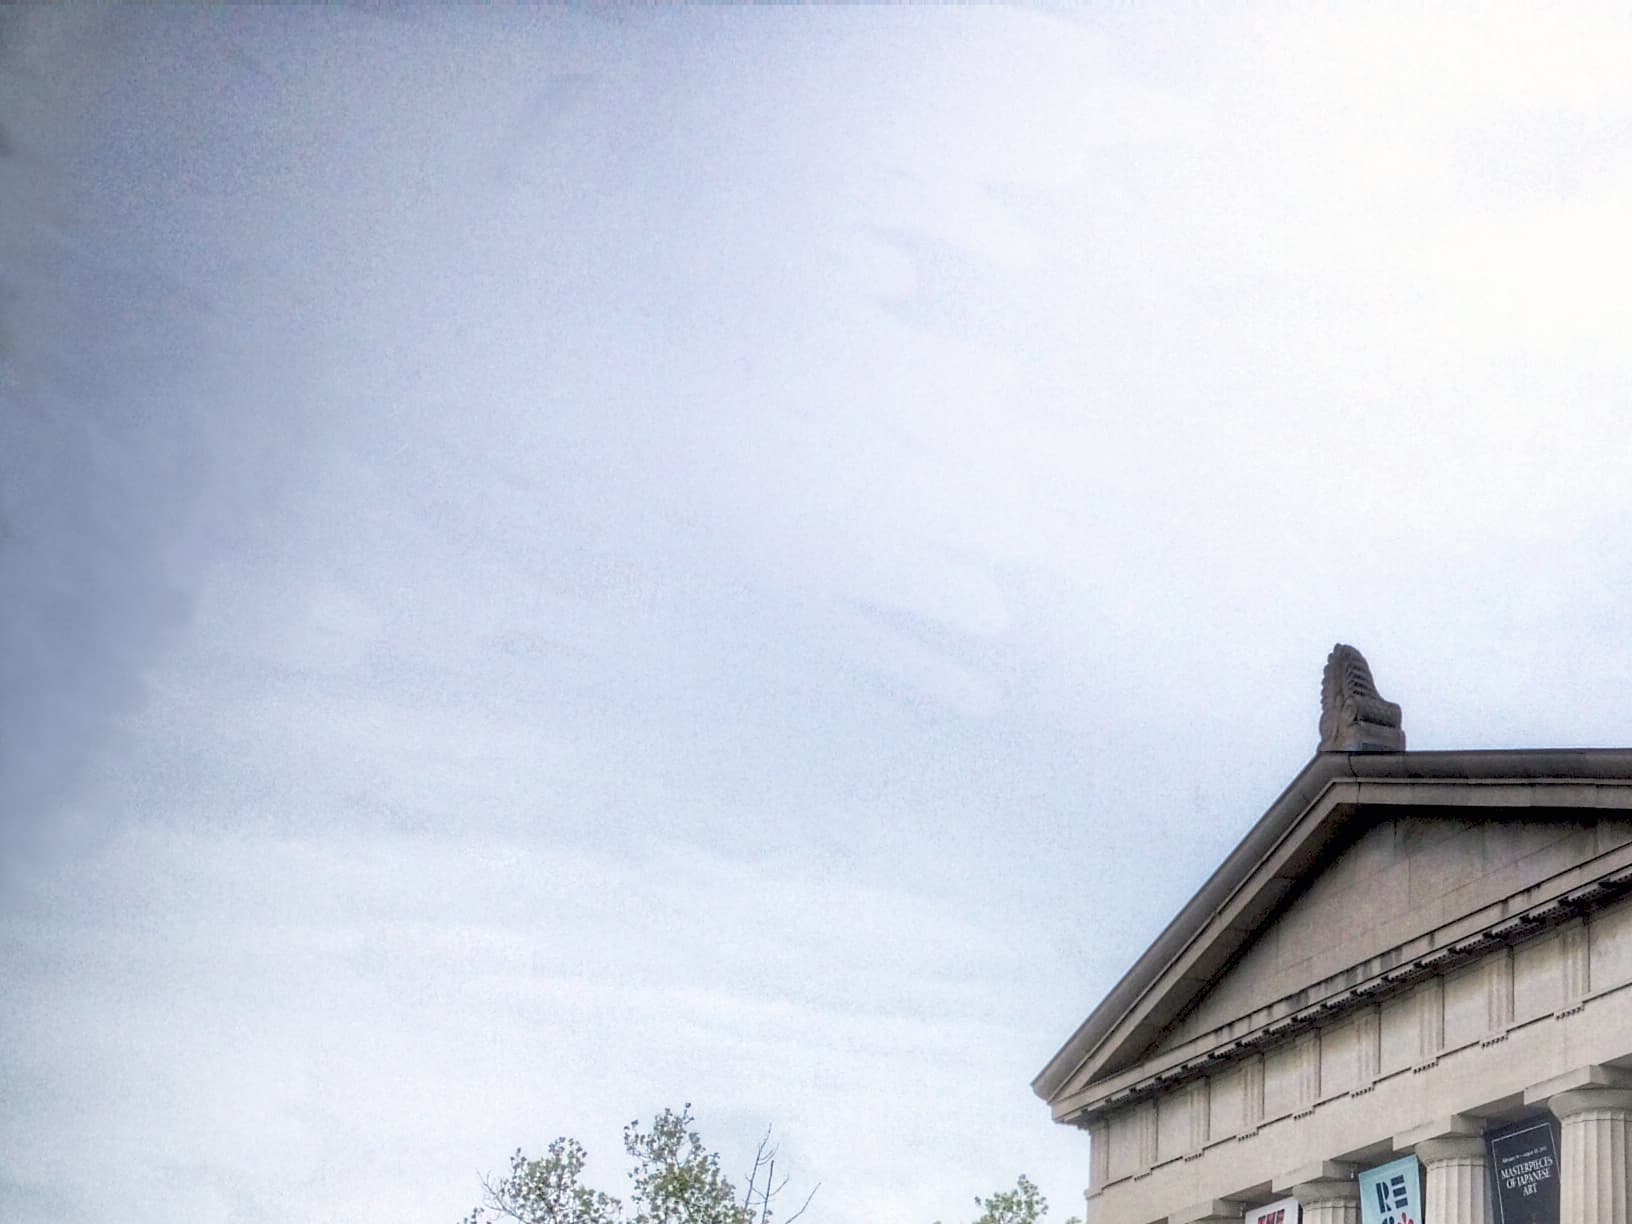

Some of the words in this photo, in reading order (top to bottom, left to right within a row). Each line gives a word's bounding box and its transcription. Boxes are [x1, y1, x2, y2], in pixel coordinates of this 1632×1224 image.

[1500, 1156, 1553, 1179] MASTERPIECES
[1506, 1177, 1516, 1189] OF
[1516, 1167, 1551, 1187] JAPANESE
[1523, 1182, 1538, 1196] ART
